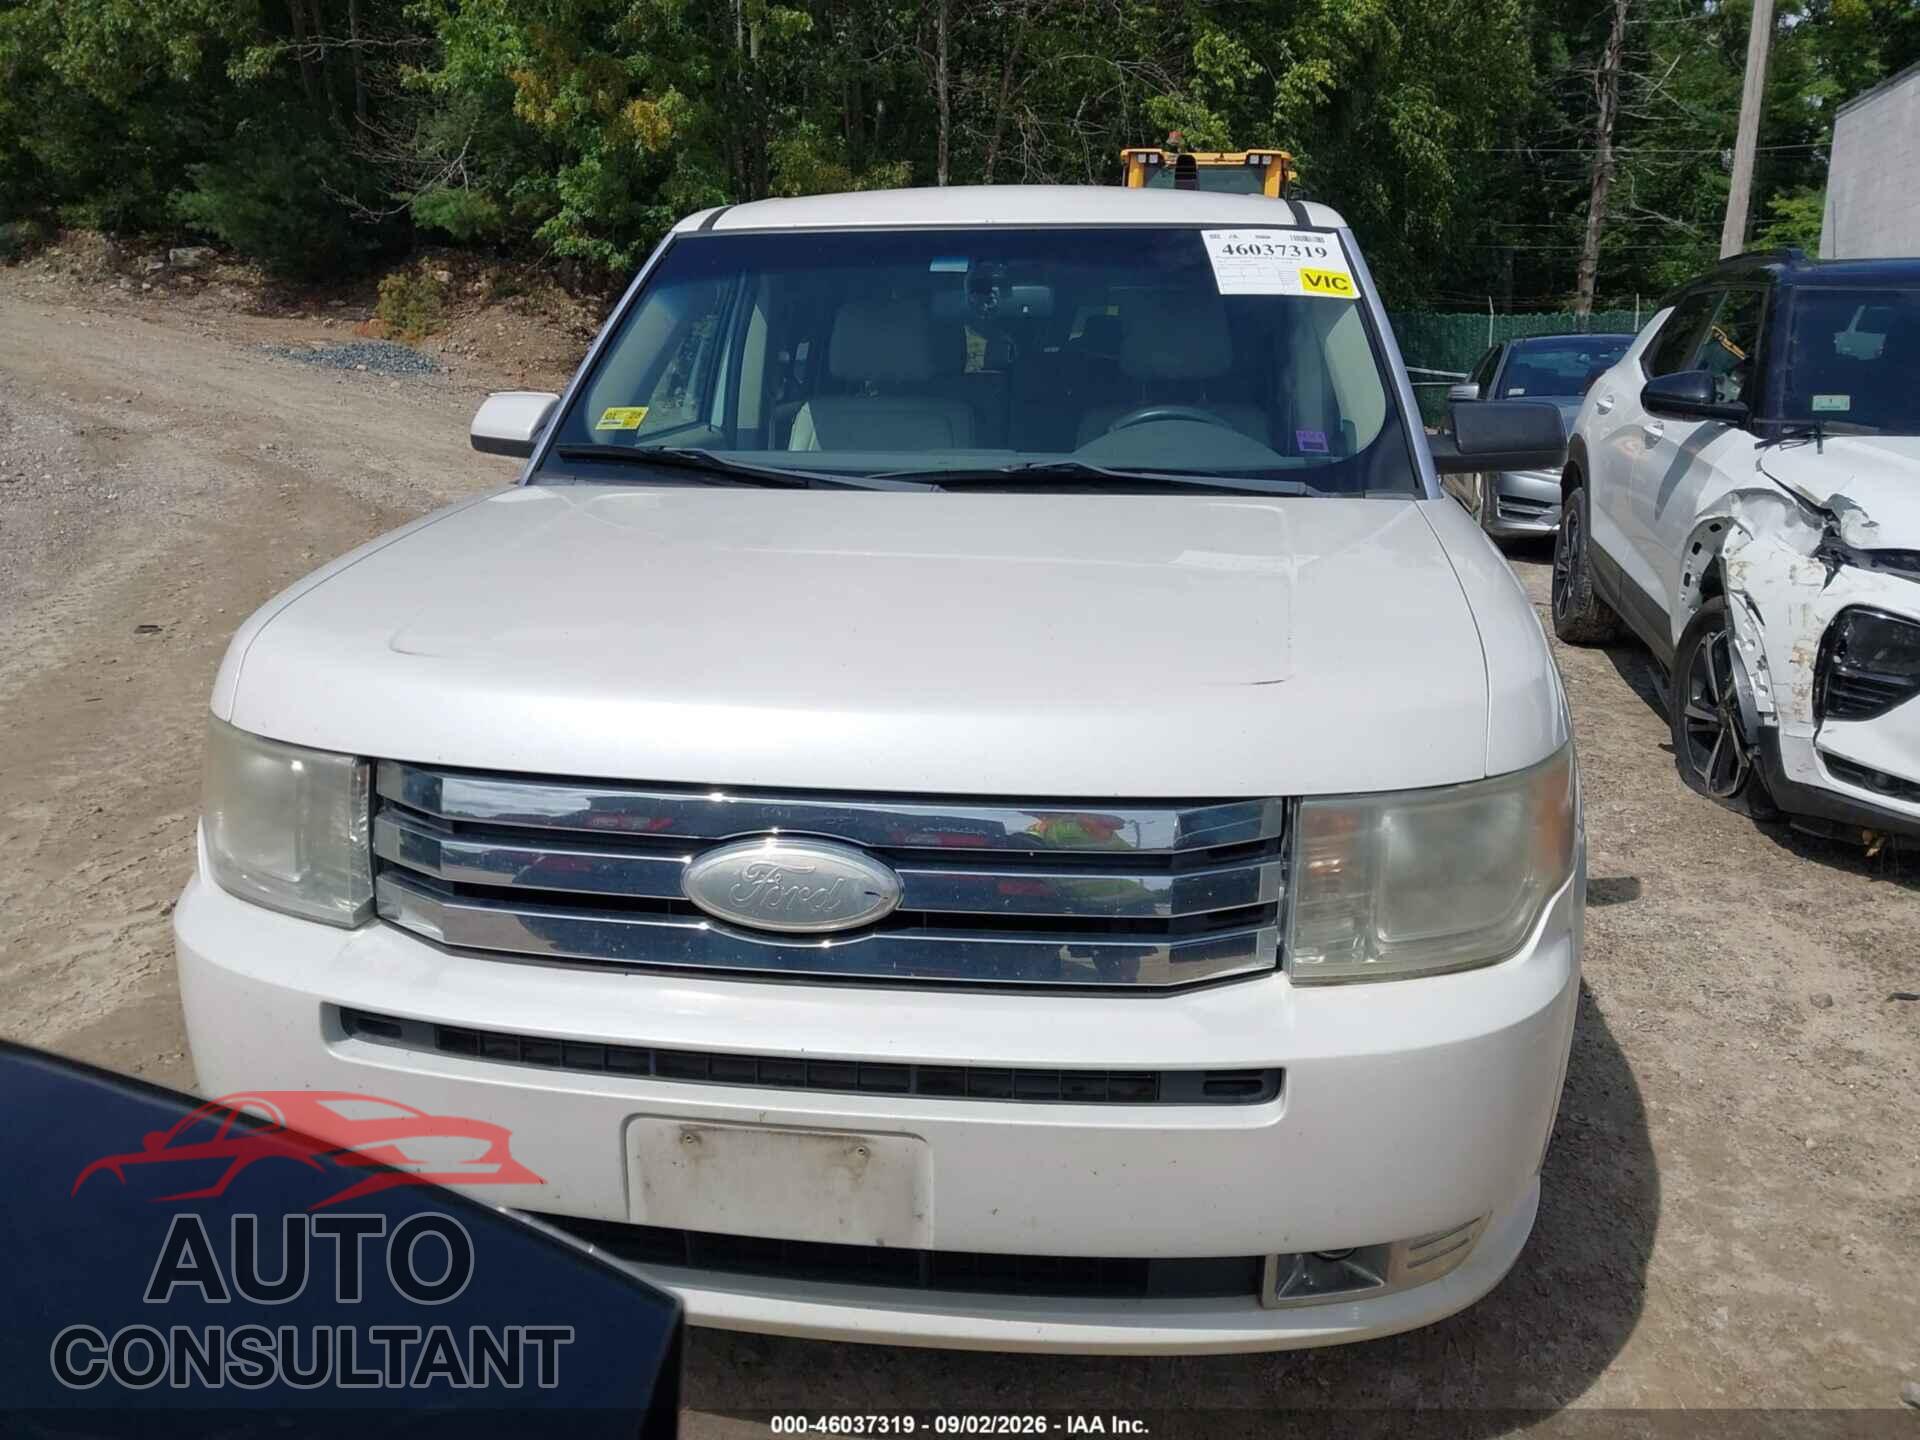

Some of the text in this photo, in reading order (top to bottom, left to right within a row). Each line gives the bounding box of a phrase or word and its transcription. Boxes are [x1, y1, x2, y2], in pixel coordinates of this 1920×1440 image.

[1222, 243, 1328, 258] 46037319
[1304, 273, 1349, 291] VIC
[729, 860, 847, 911] Ford
